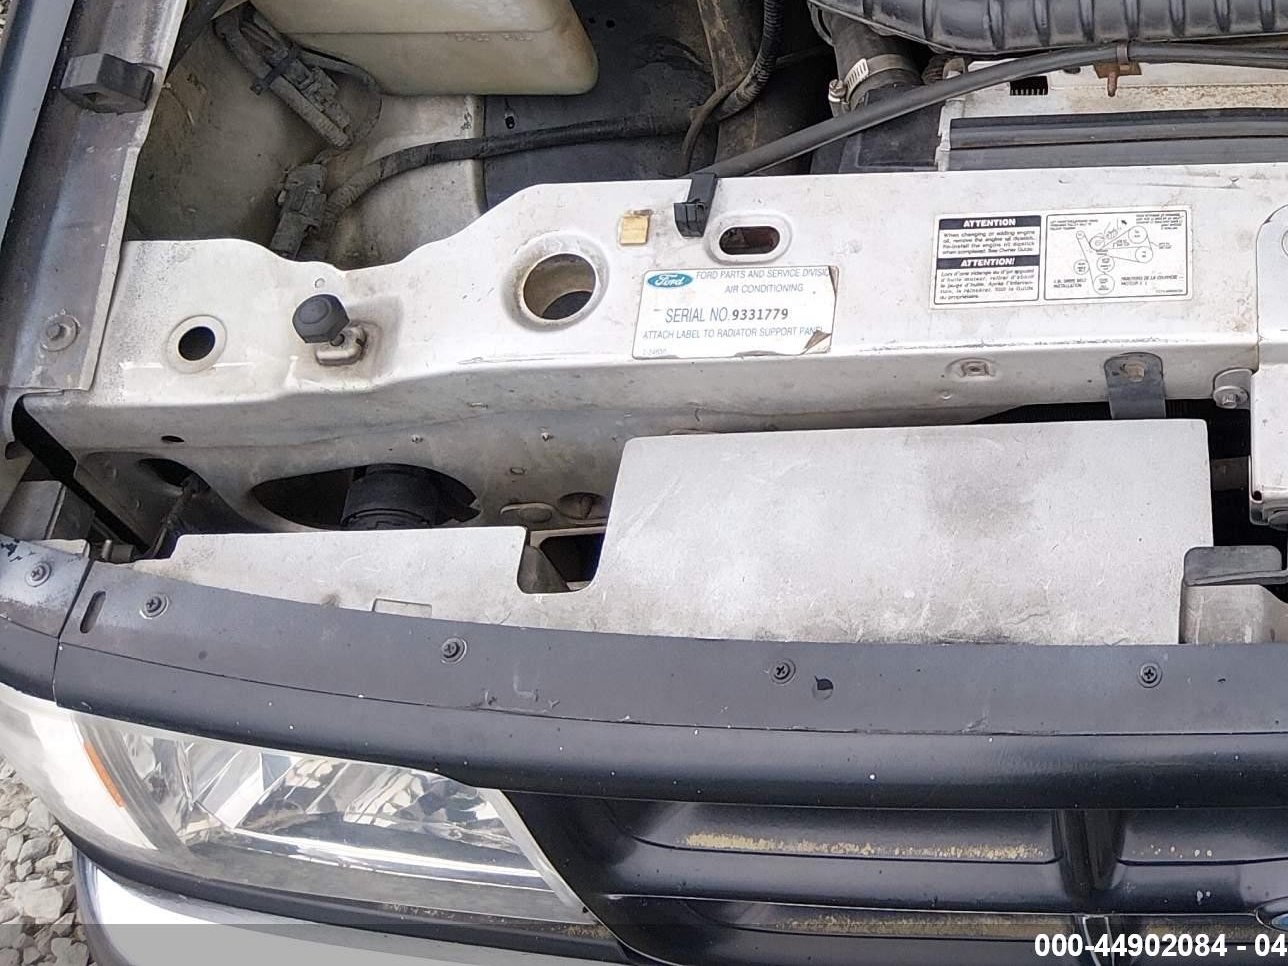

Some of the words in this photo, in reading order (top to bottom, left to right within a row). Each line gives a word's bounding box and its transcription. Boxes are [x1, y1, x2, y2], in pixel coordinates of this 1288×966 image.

[963, 218, 1016, 227] ATTENTION
[961, 258, 1015, 267] ATTENTION!
[696, 272, 719, 280] FORD
[720, 270, 746, 279] PARTS
[747, 270, 765, 278] AND
[766, 269, 801, 279] SERVICE
[655, 274, 685, 287] Ford
[724, 285, 740, 294] AIR
[741, 283, 804, 294] CONDITIONING
[665, 307, 706, 323] SERIAL
[731, 308, 789, 321] 9331779
[642, 330, 675, 339] ATTACH
[676, 329, 702, 339] LABEL
[704, 329, 716, 338] TO
[717, 327, 757, 338] RADIATOR
[759, 326, 797, 337] SUPPORT
